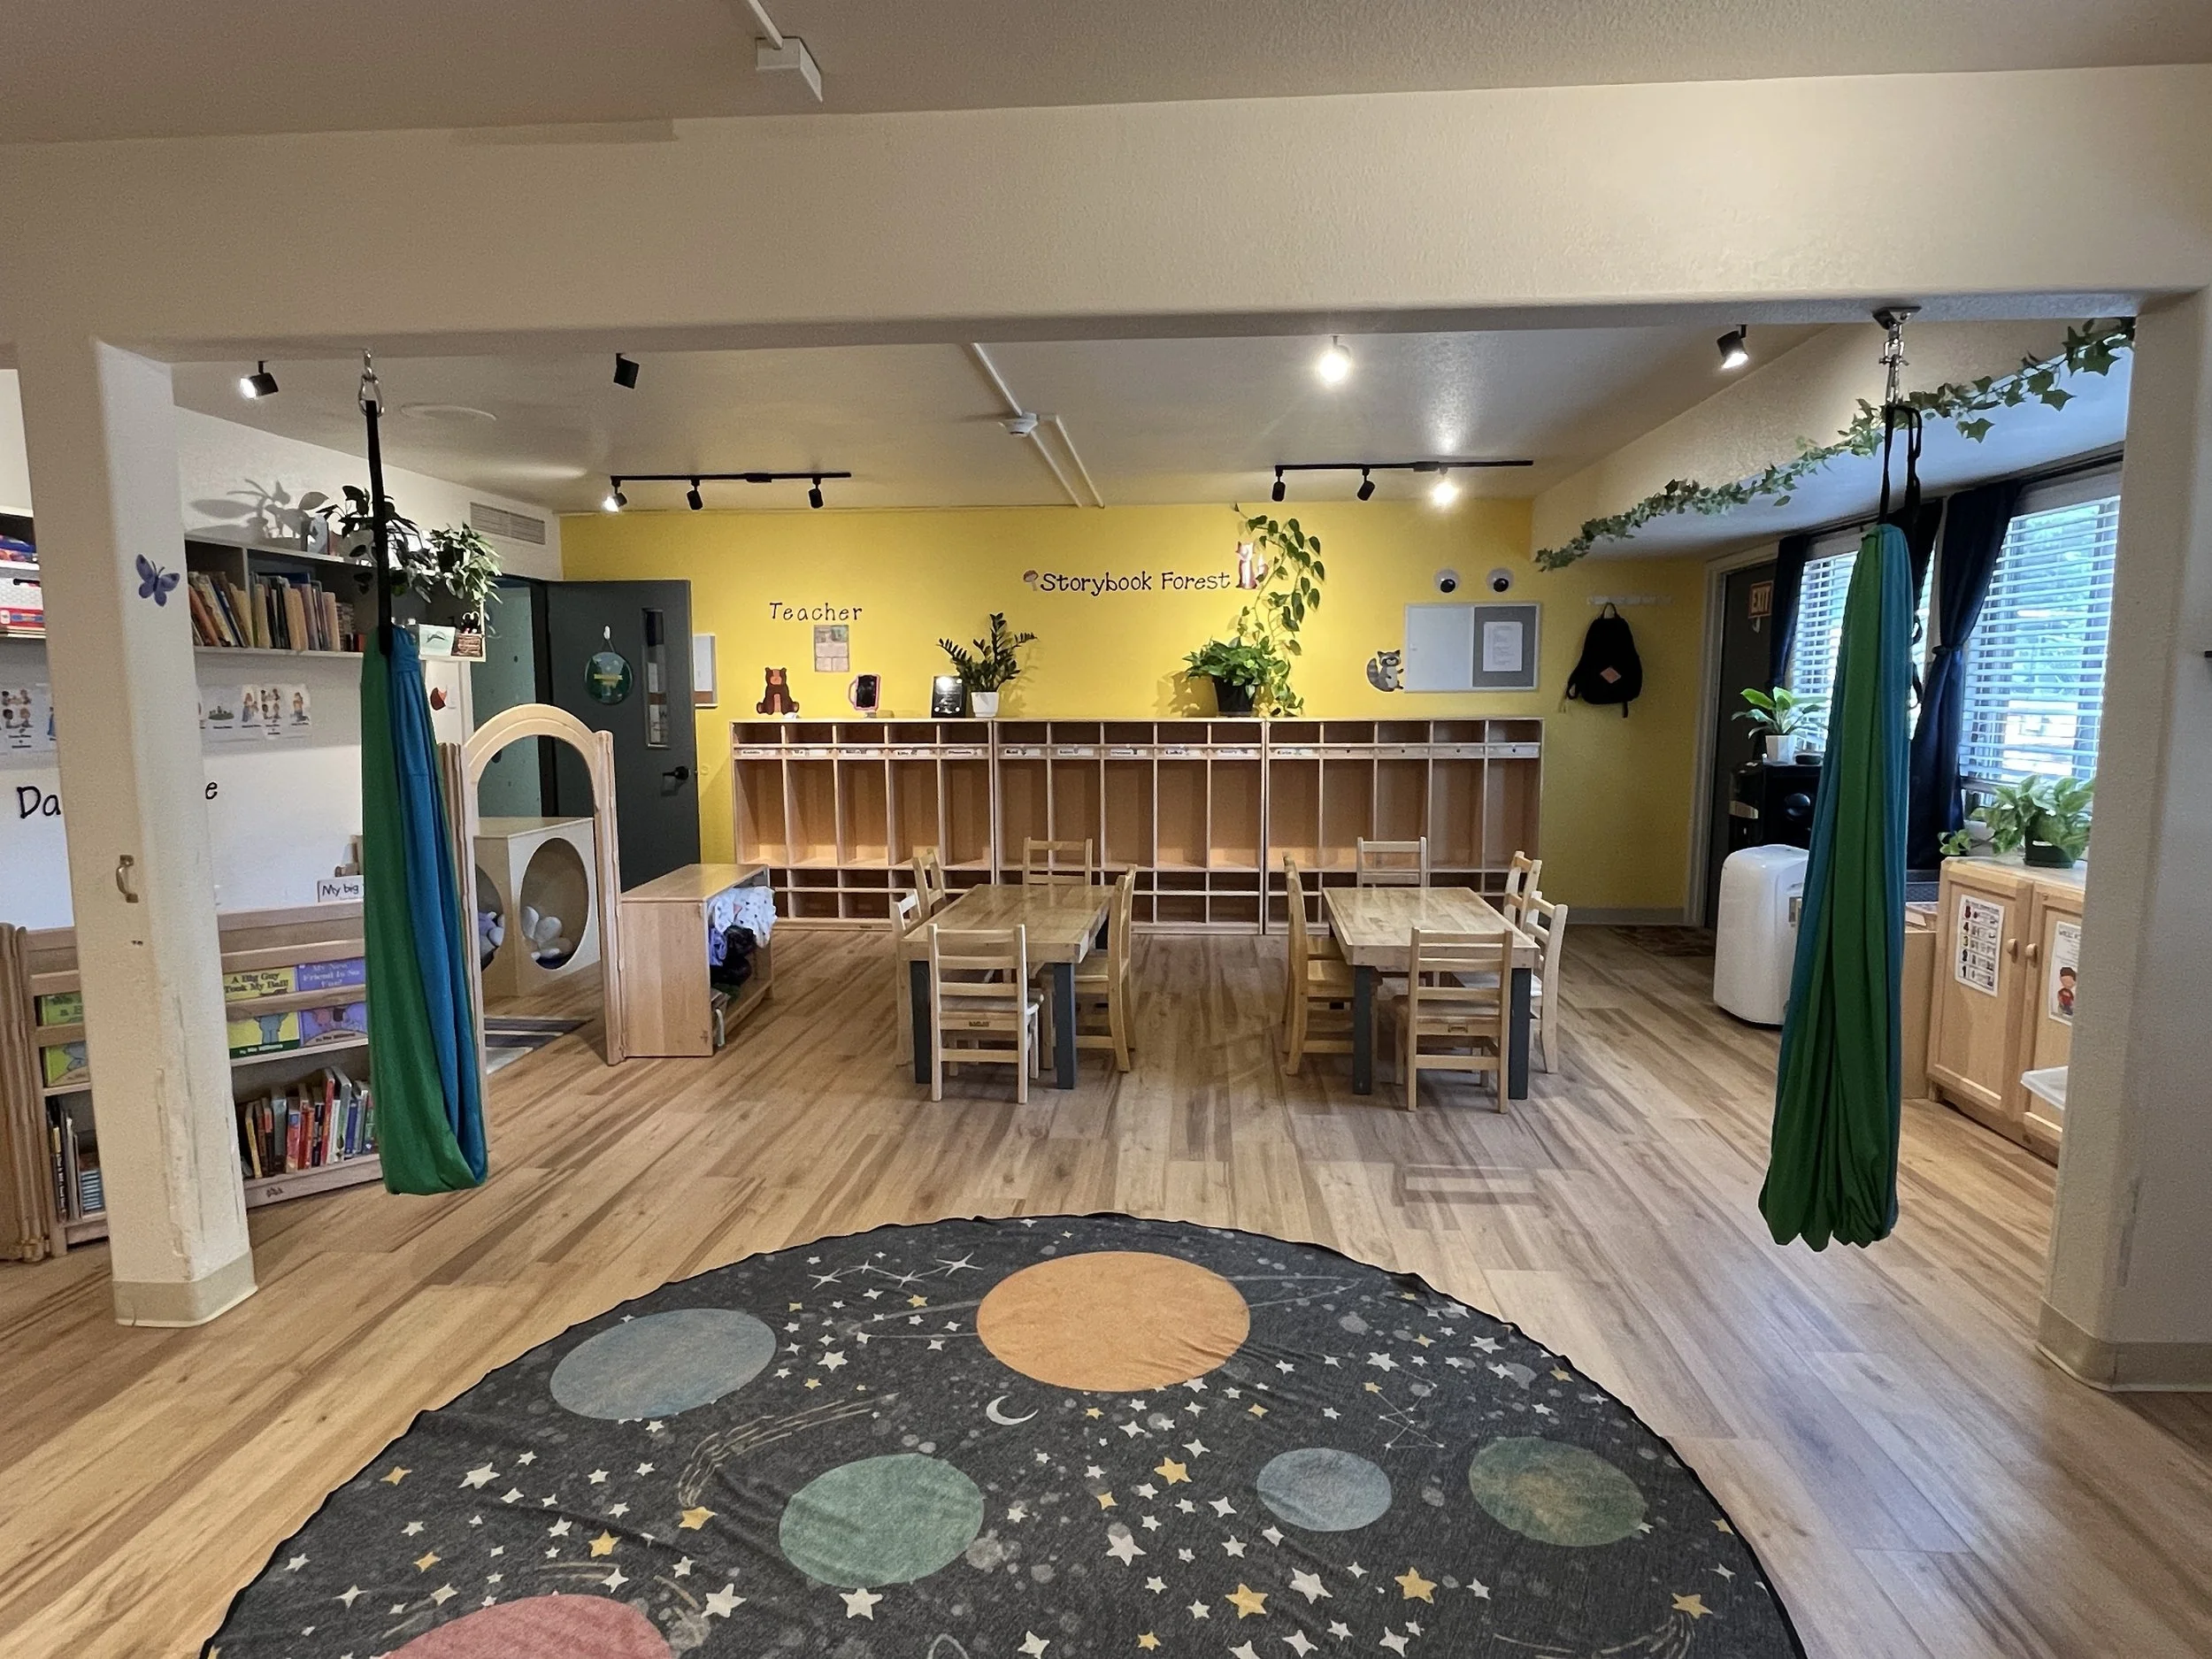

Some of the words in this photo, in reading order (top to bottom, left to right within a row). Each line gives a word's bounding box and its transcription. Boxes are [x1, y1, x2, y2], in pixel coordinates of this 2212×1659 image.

[1040, 571, 1152, 596] Storybook
[1161, 572, 1231, 590] Forest
[1751, 586, 1771, 612] EXIT
[769, 603, 863, 621] Teacher
[16, 786, 62, 819] Da
[322, 884, 341, 897] My
[343, 883, 359, 895] big
